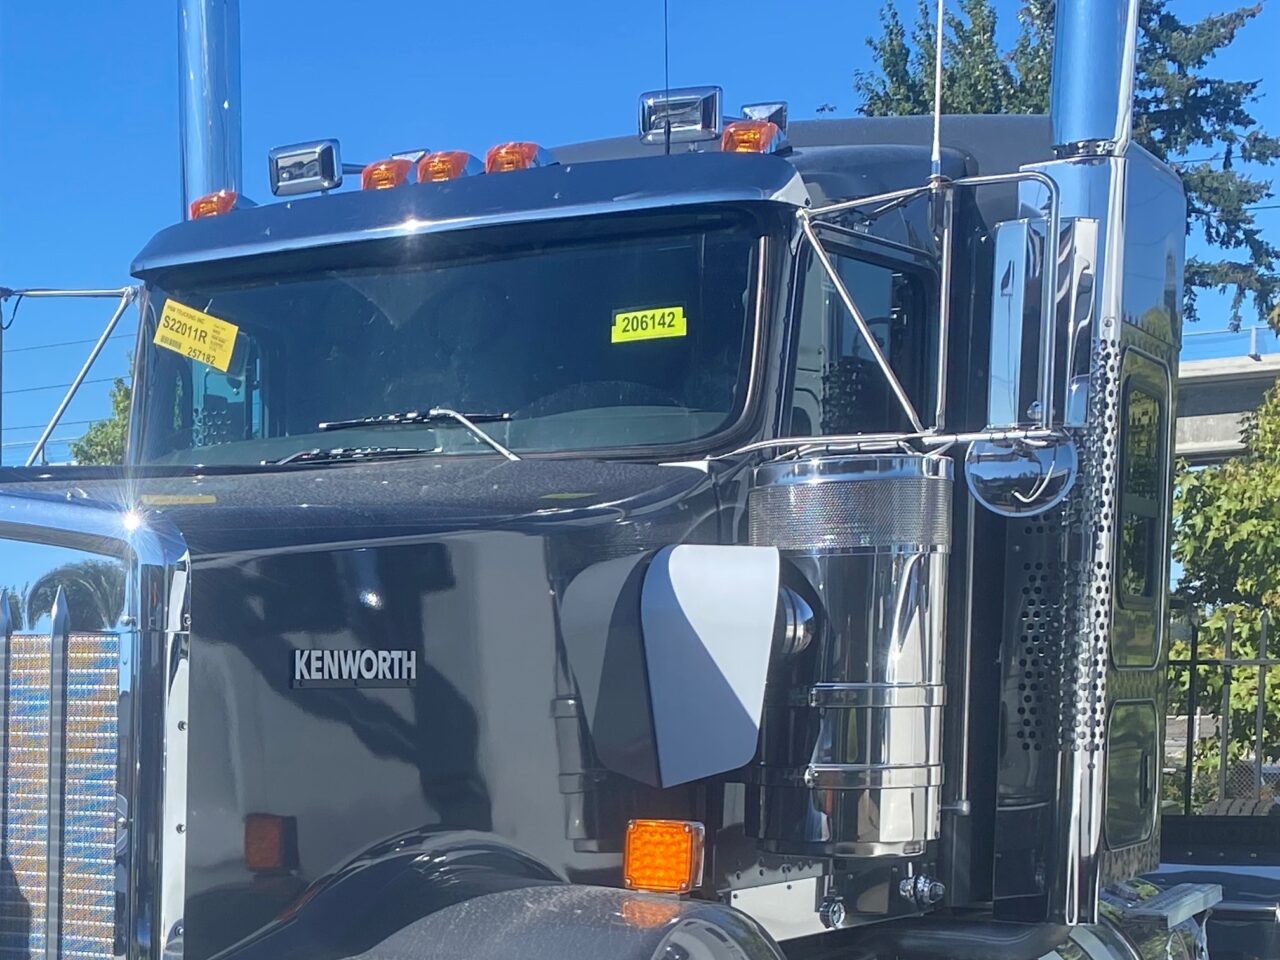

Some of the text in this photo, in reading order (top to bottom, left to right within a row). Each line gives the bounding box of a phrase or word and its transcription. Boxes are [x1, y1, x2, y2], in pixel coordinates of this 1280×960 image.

[163, 315, 208, 344] S22011R
[621, 311, 675, 334] 206142
[187, 346, 216, 365] 257182
[295, 649, 417, 680] KENWORTH
